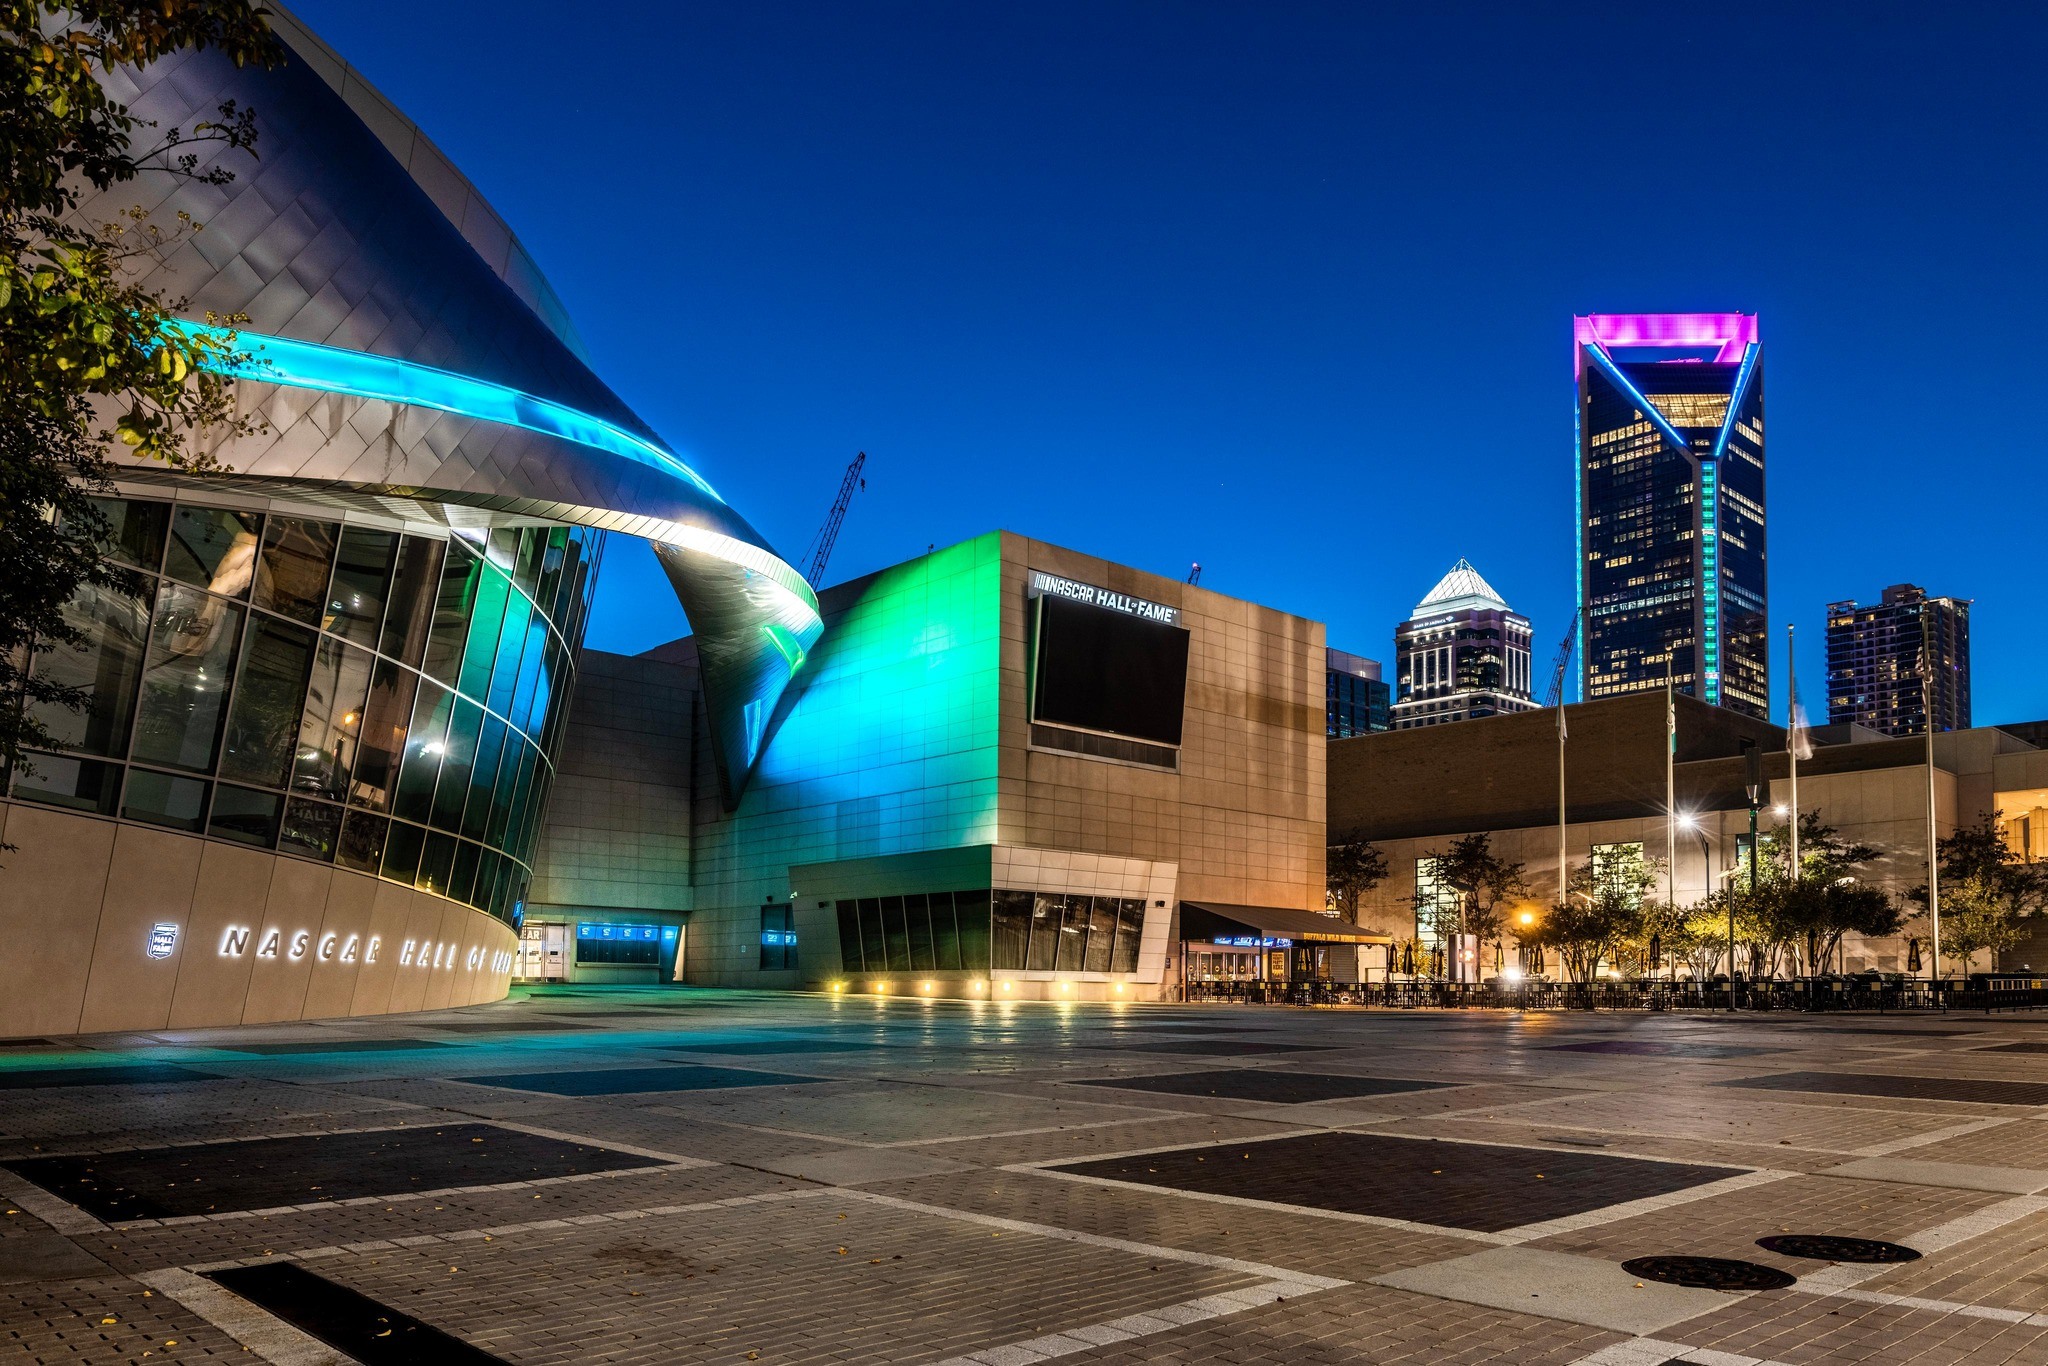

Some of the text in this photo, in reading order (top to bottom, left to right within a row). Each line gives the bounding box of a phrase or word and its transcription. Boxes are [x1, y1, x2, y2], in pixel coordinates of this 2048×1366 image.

[1047, 578, 1173, 623] NASCAR HALL OF FAME
[220, 926, 382, 963] NASCAR
[400, 939, 458, 970] HALL
[520, 929, 540, 940] EAR
